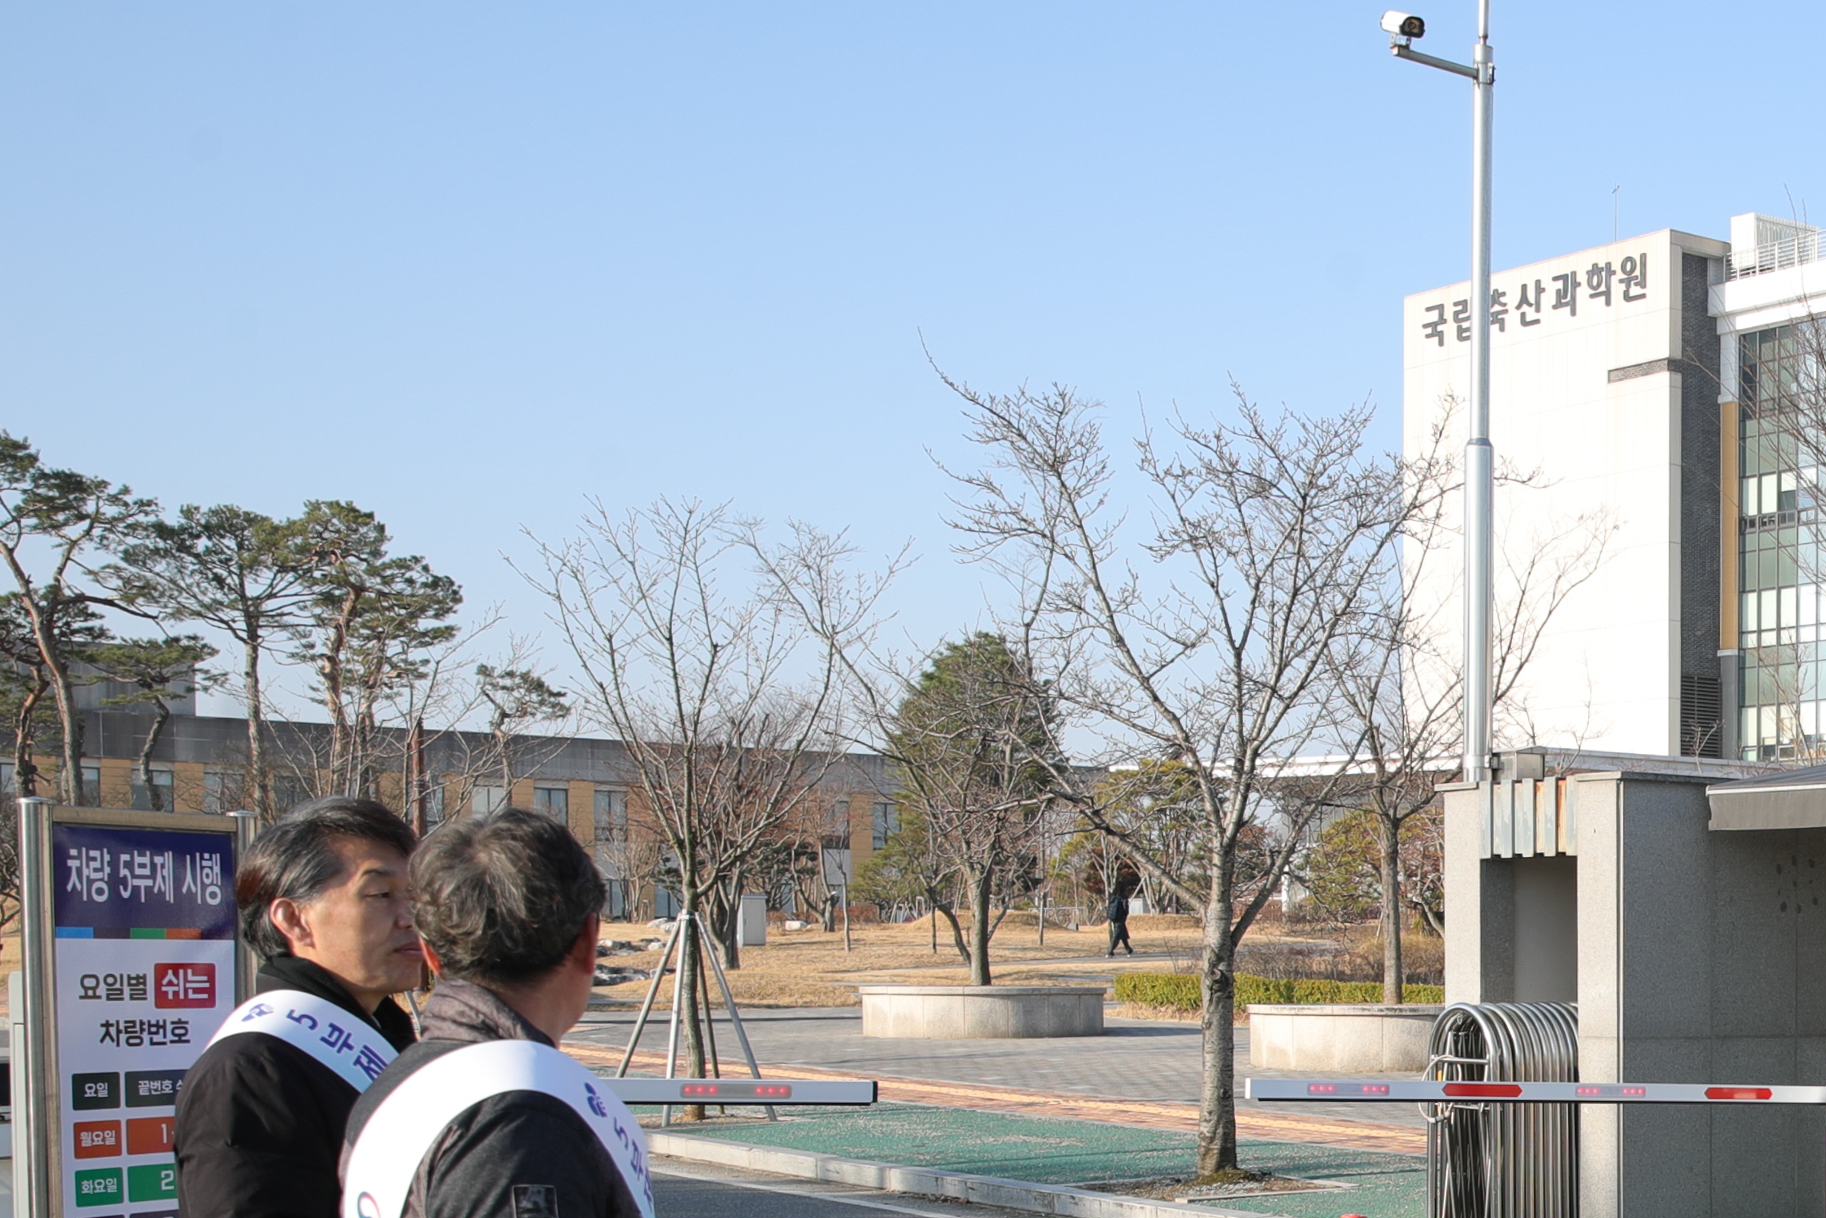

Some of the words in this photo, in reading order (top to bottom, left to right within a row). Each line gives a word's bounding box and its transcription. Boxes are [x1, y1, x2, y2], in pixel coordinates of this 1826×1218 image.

[66, 846, 112, 902] 차량
[119, 850, 174, 903] 5부제
[181, 852, 222, 906] 시행
[78, 972, 148, 1001] 요일별
[161, 968, 211, 1000] 쉬는
[99, 1018, 191, 1047] 차량번호
[84, 1082, 109, 1098] 요일
[138, 1079, 174, 1096] 끝번호
[80, 1130, 116, 1147] 월요일
[81, 1178, 118, 1195] 화요일
